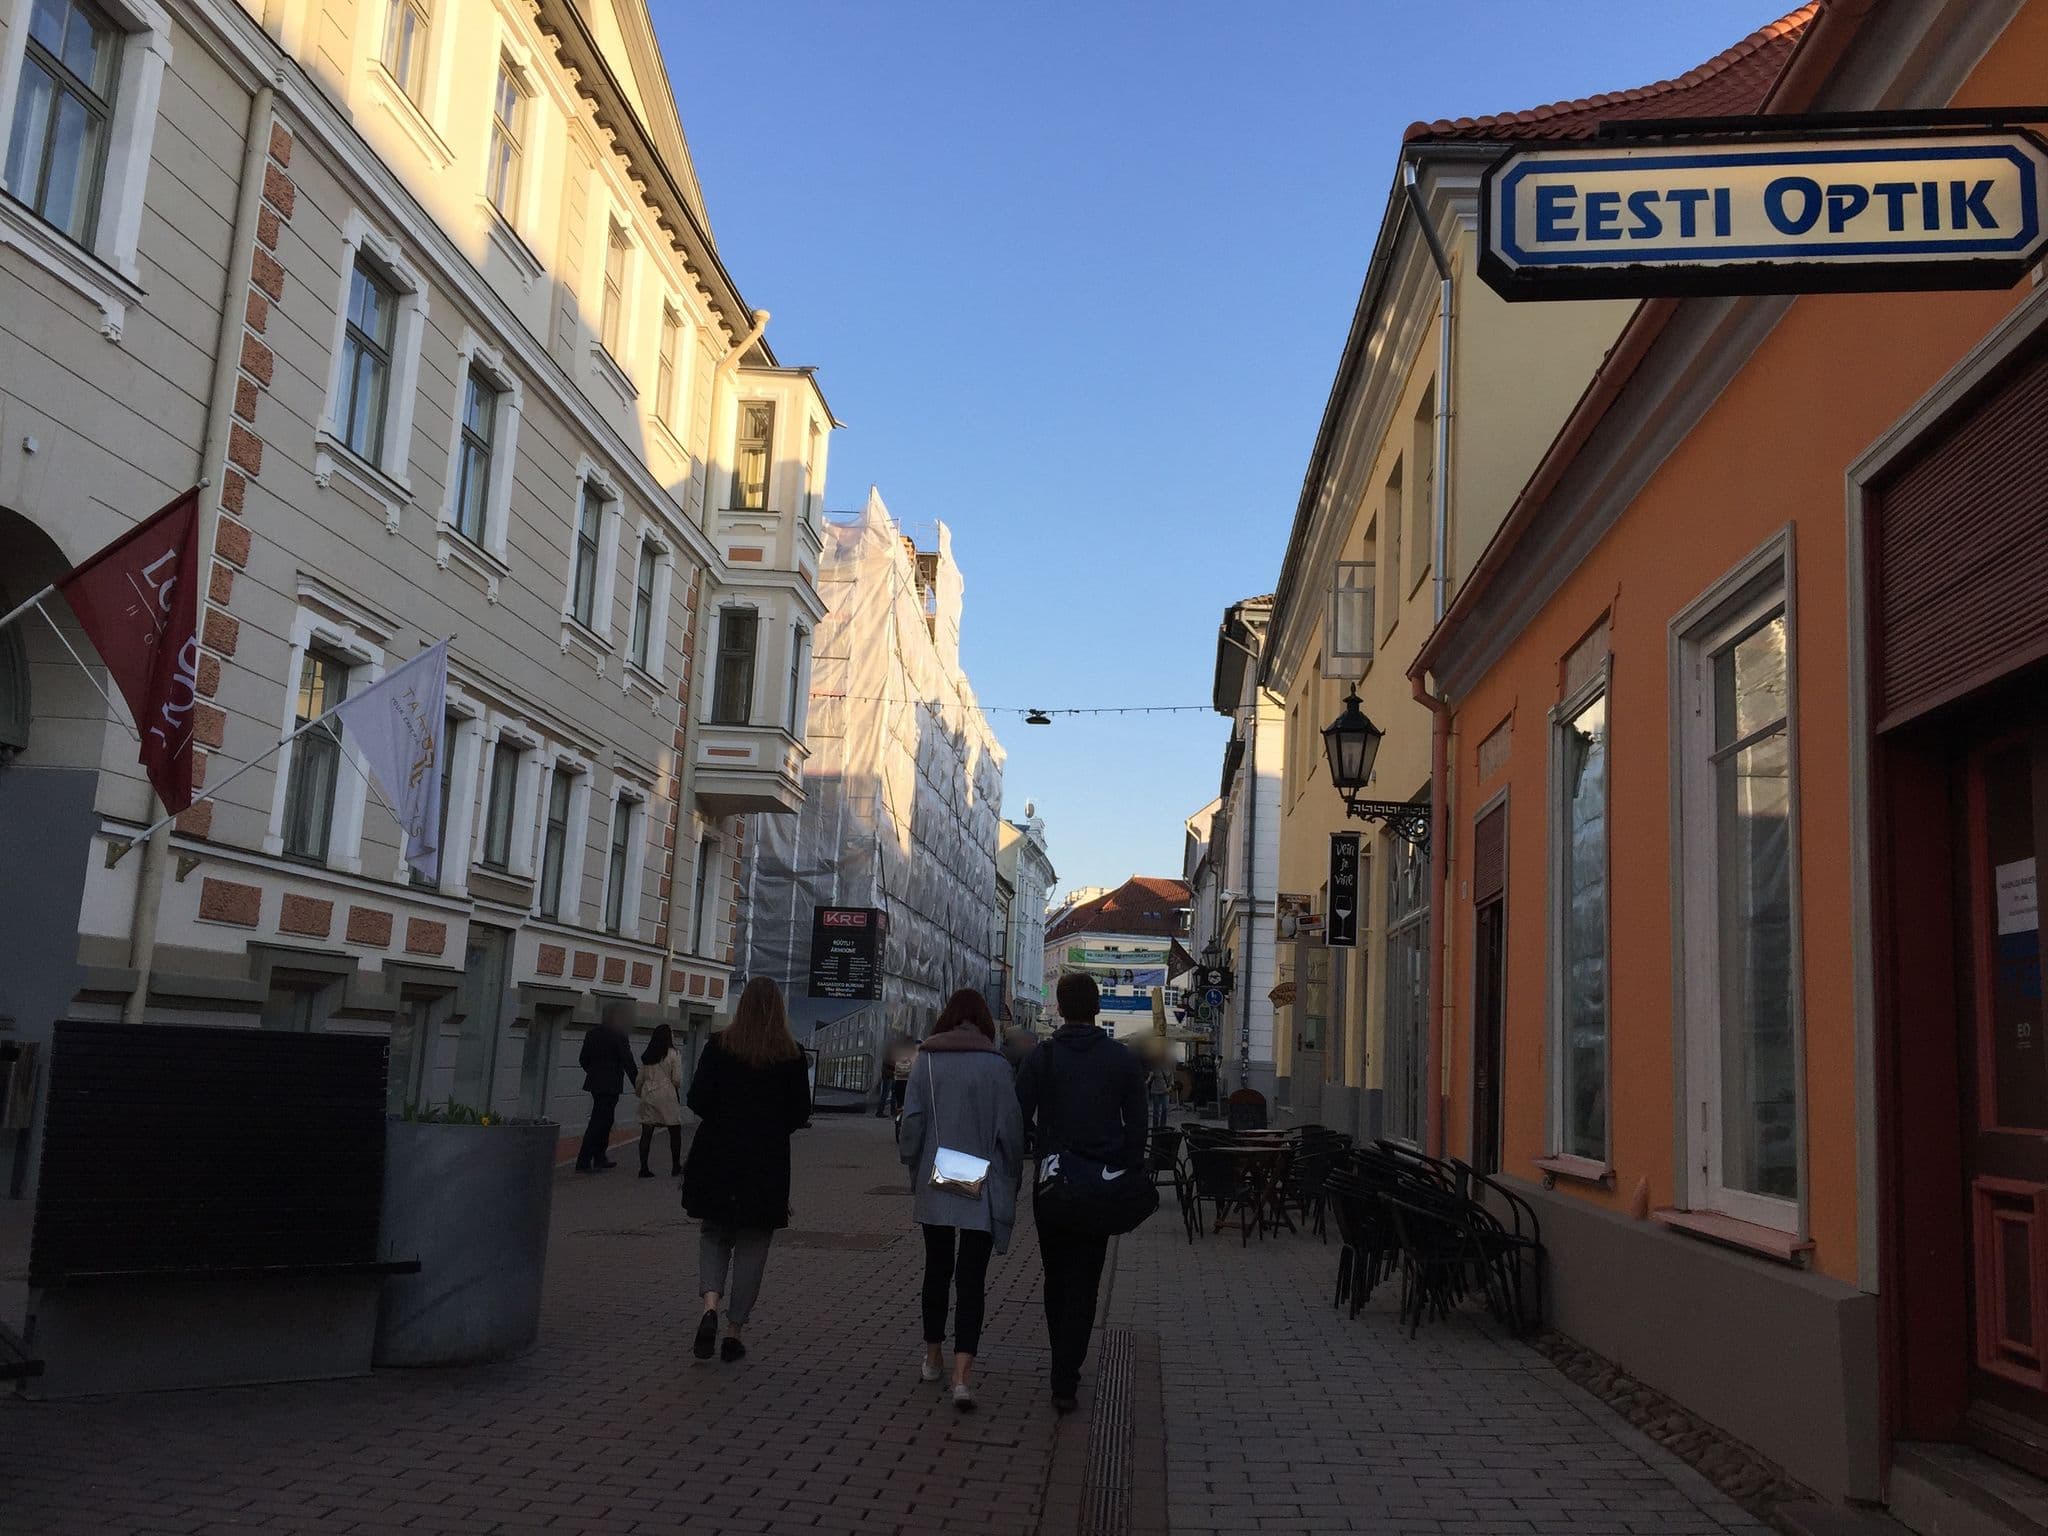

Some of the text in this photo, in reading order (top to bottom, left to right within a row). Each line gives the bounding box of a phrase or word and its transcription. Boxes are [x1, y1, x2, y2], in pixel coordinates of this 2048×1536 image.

[1535, 176, 1999, 242] EESTI OPTIK
[826, 913, 865, 925] KRC
